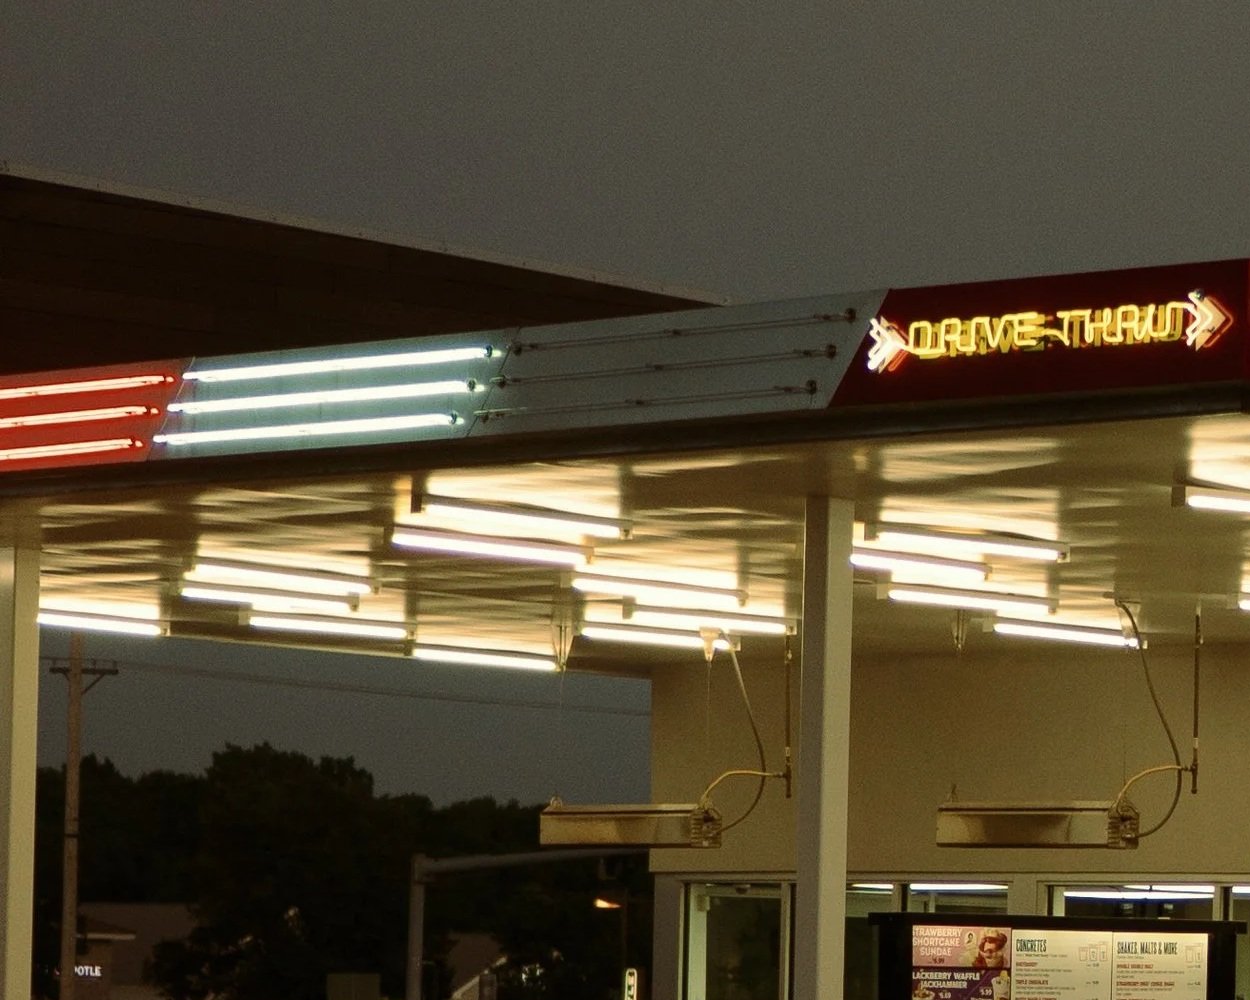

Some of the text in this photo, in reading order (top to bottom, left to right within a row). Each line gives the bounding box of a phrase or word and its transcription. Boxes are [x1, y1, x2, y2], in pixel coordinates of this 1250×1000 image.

[1016, 938, 1047, 953] CONCRETES
[920, 947, 952, 956] SUNDAE
[912, 972, 952, 980] LACKBERRY
